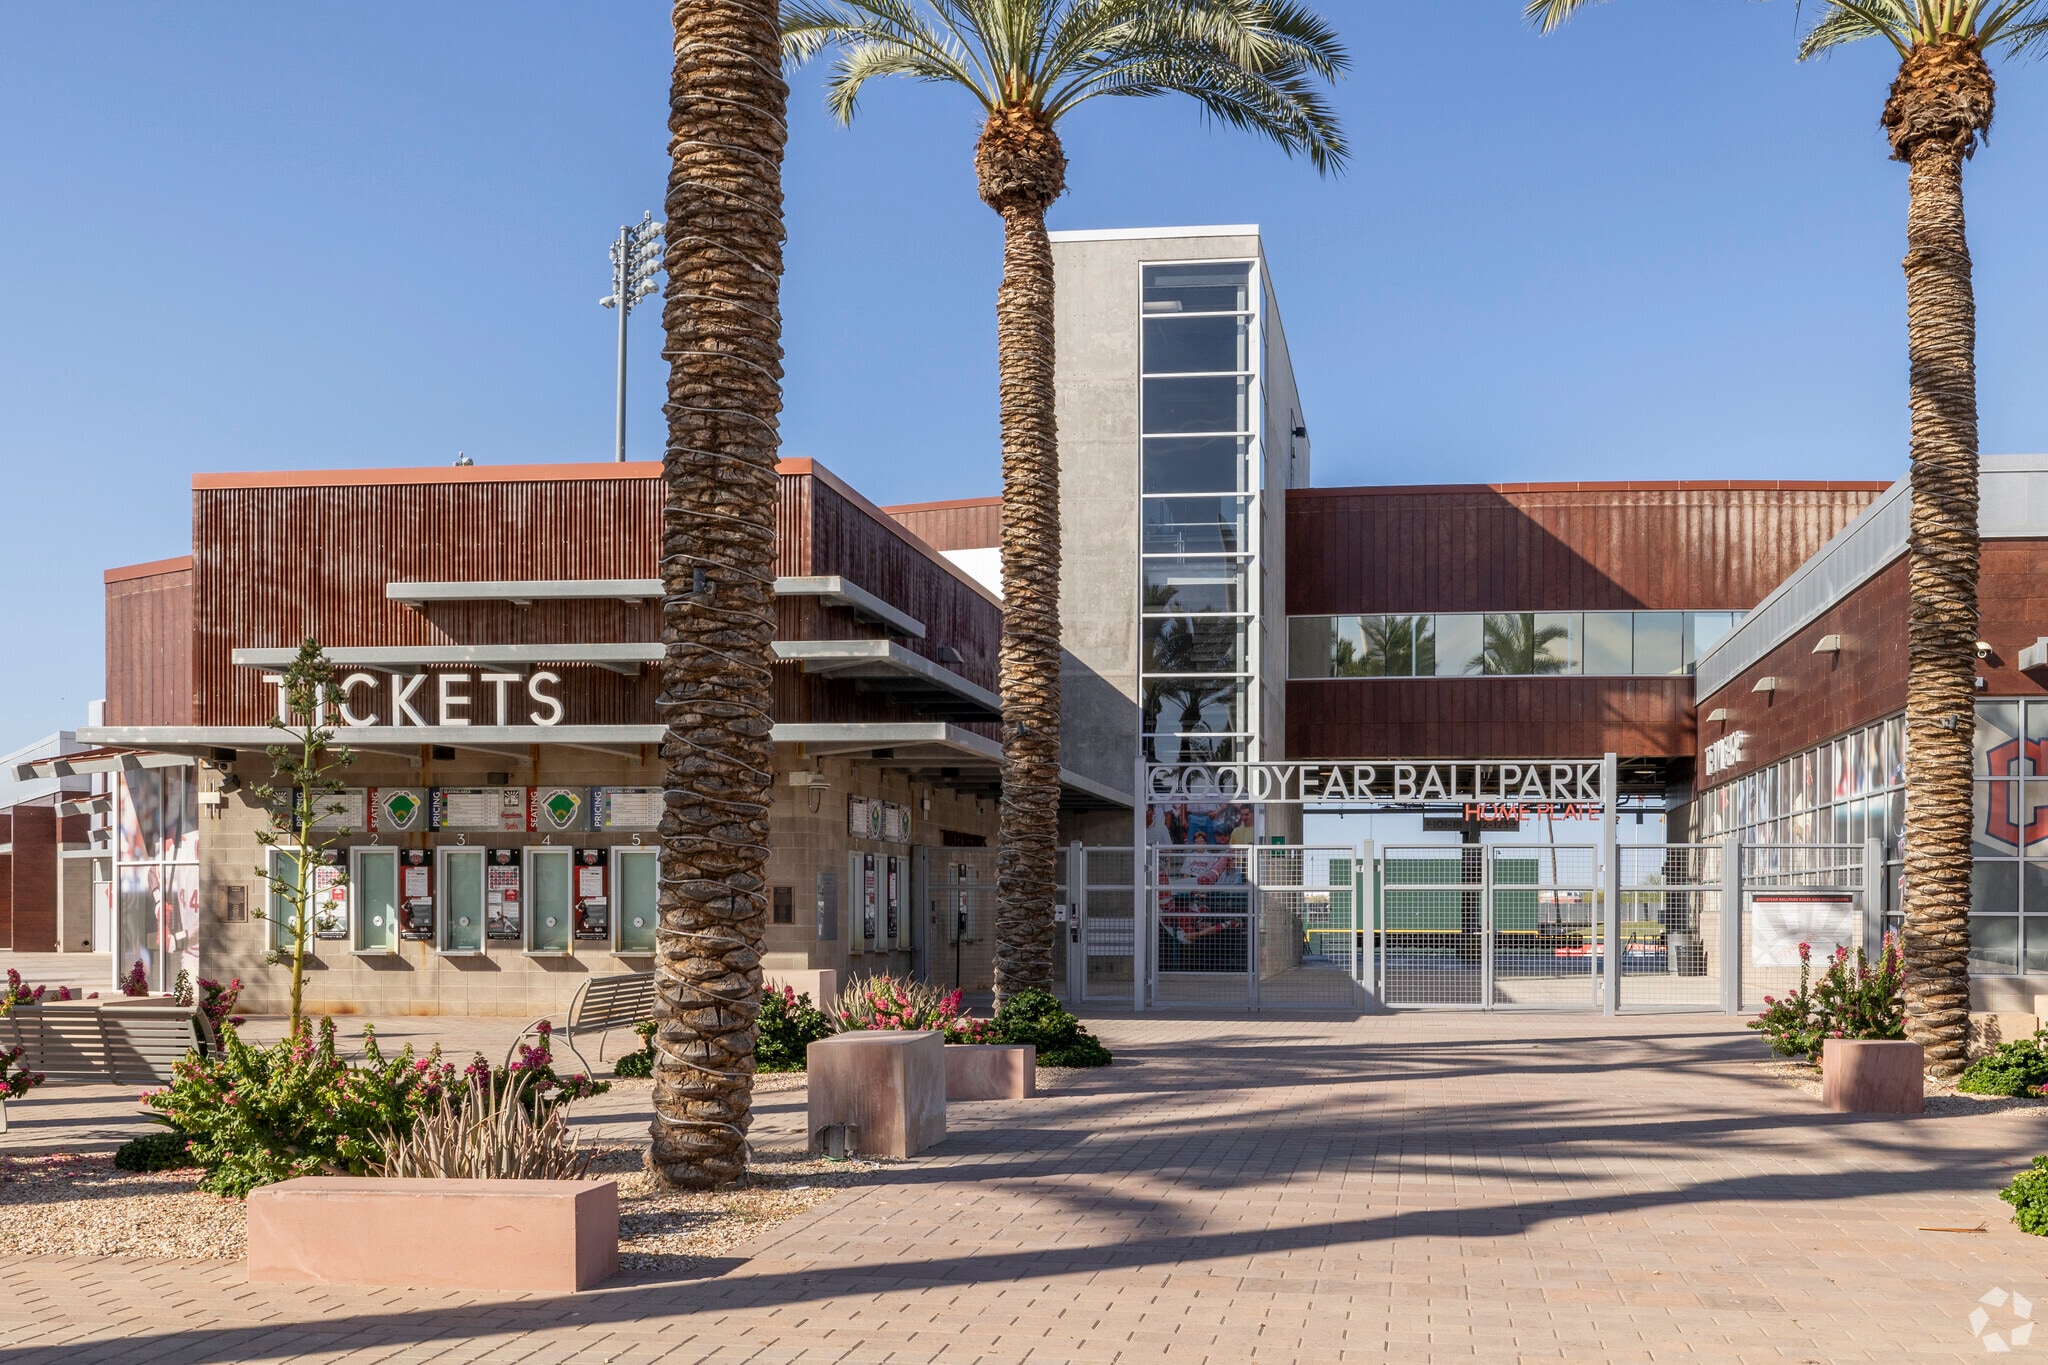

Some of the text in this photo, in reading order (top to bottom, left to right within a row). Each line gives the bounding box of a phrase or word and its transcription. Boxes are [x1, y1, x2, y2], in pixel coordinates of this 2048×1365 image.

[262, 672, 565, 727] TICKETS
[1148, 765, 1601, 801] GOODYEAR BALLPARK
[1464, 803, 1601, 821] HOME PLATE
[370, 834, 379, 845] 2
[456, 834, 465, 845] 3
[542, 834, 550, 845] 4
[632, 834, 640, 845] 5
